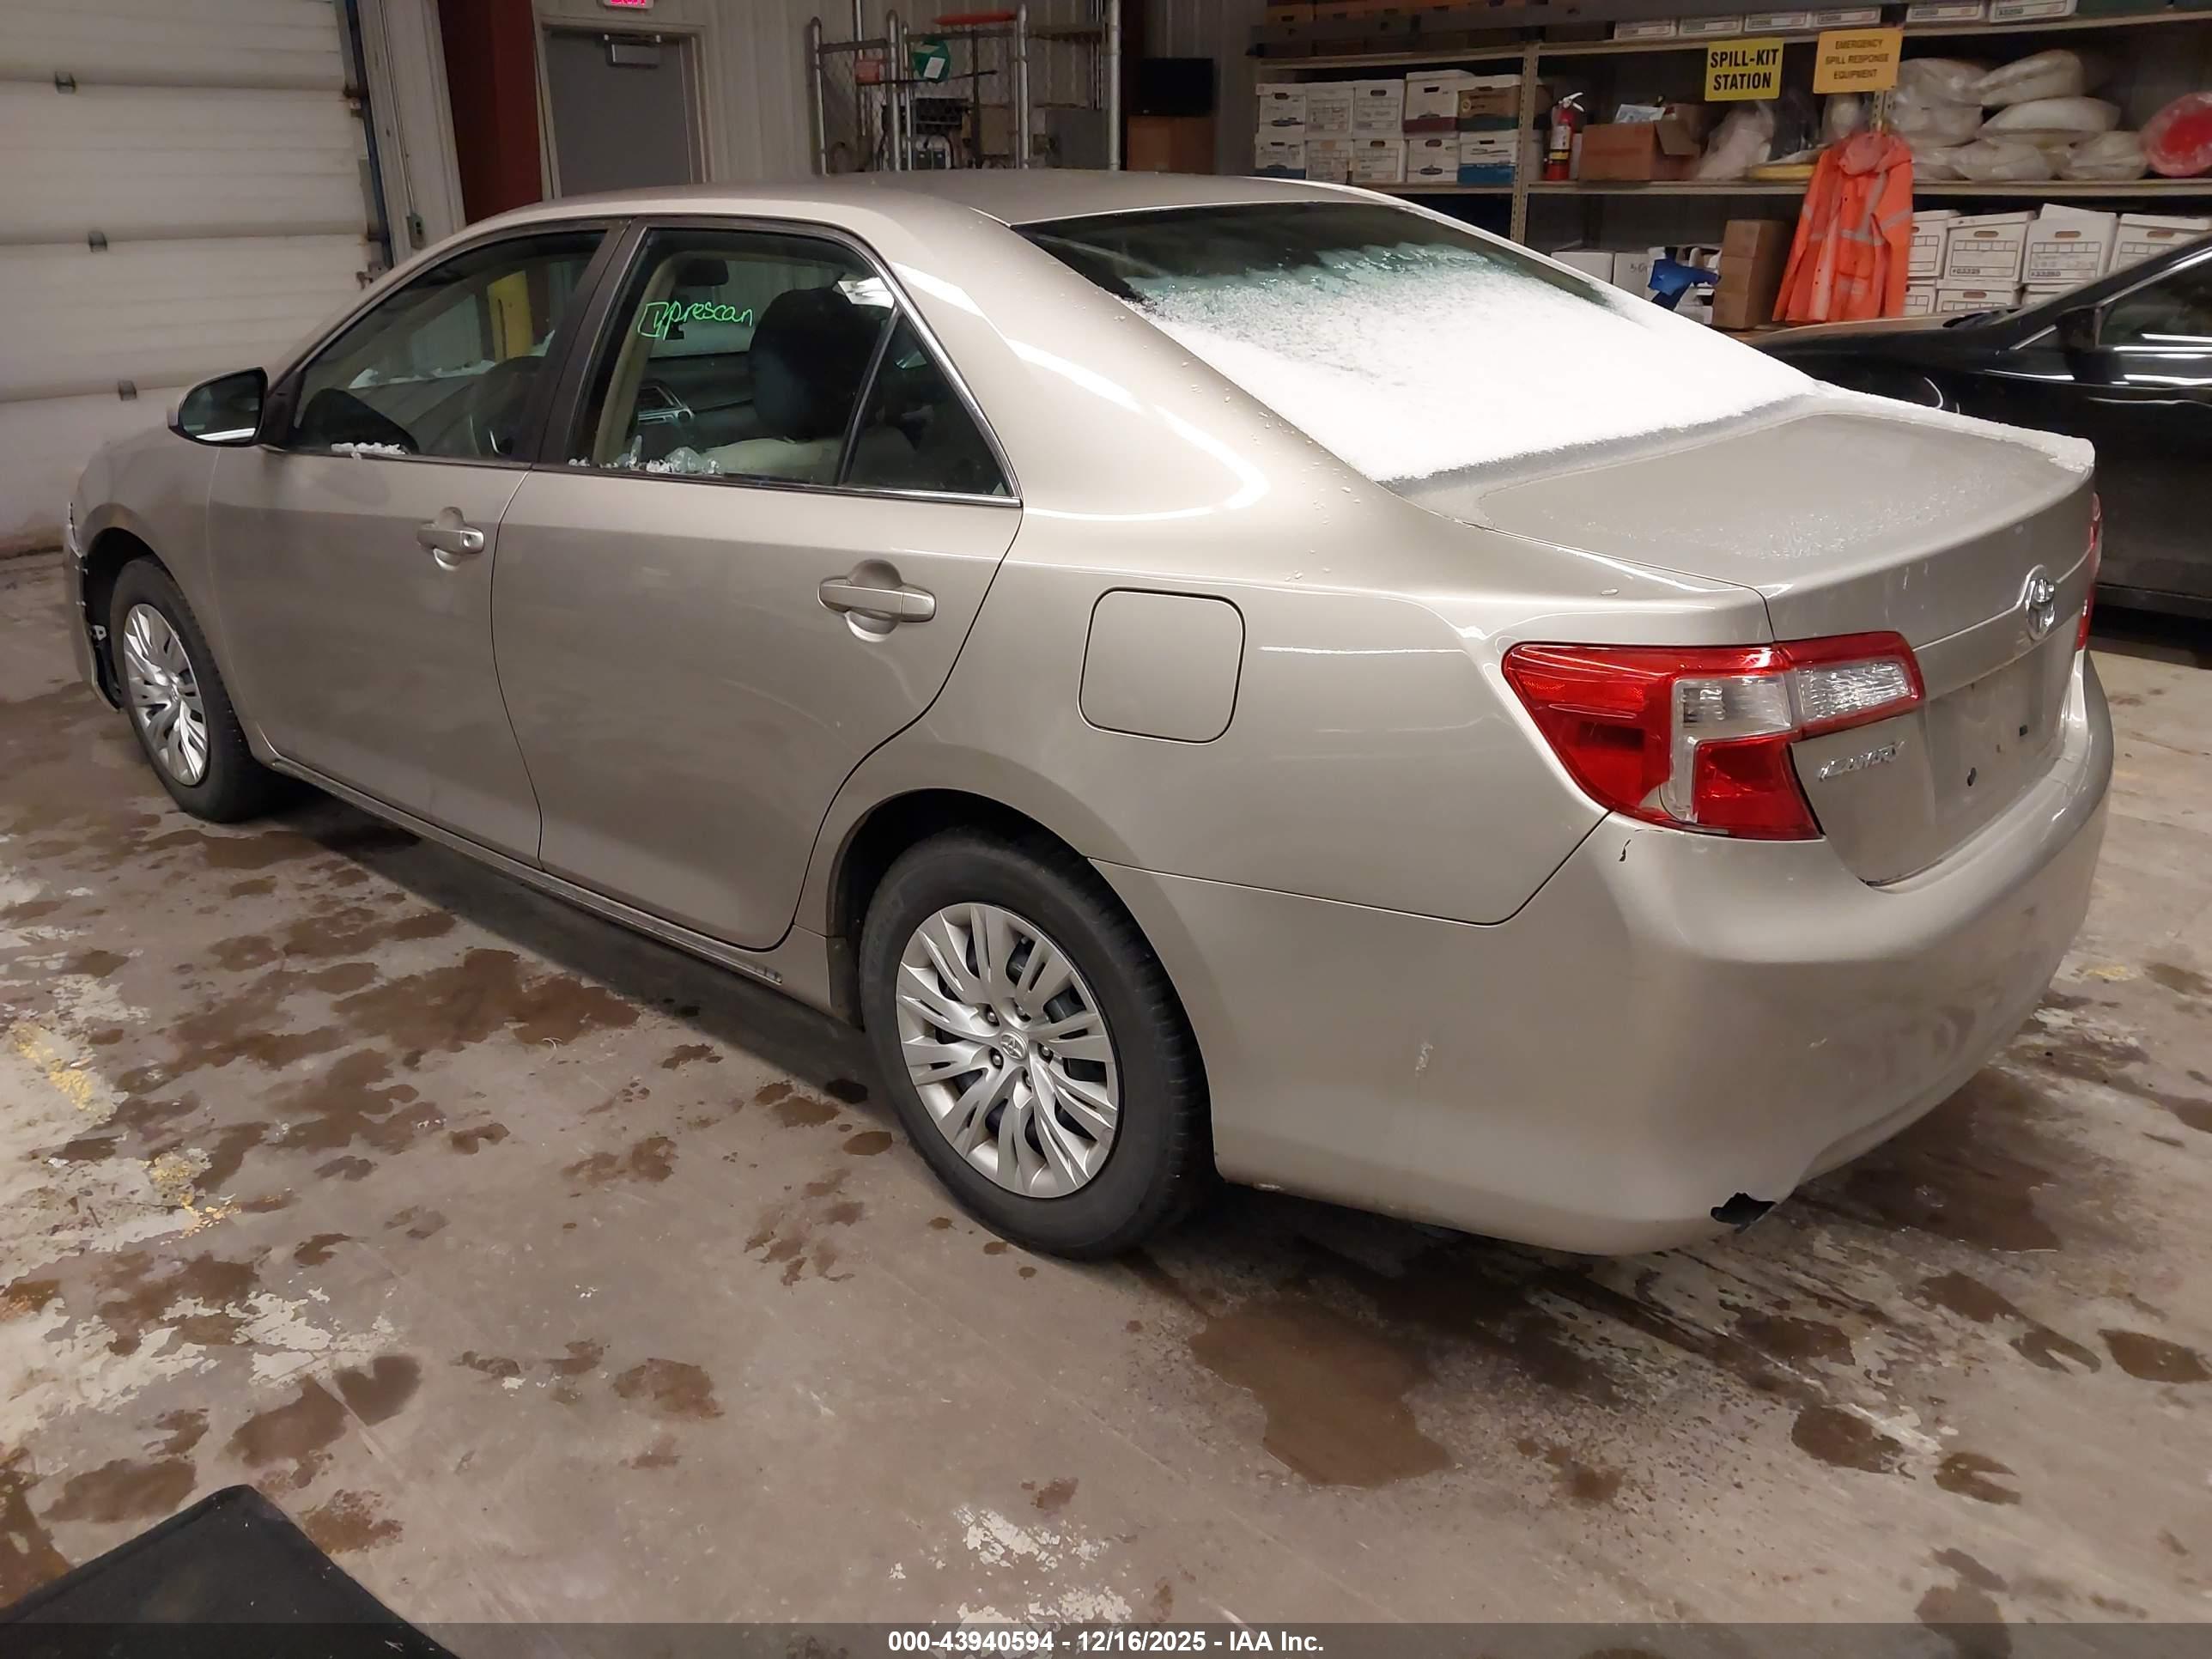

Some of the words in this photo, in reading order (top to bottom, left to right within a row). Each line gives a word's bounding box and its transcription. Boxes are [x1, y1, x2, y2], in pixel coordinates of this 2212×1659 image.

[1835, 39, 1883, 49] EMERGENCY
[1710, 48, 1780, 68] SPILL-KIT
[1826, 56, 1845, 64] SPILL
[1848, 53, 1889, 64] RESPONSE
[1833, 69, 1878, 80] EQUIPMENT
[1713, 71, 1772, 91] STATION
